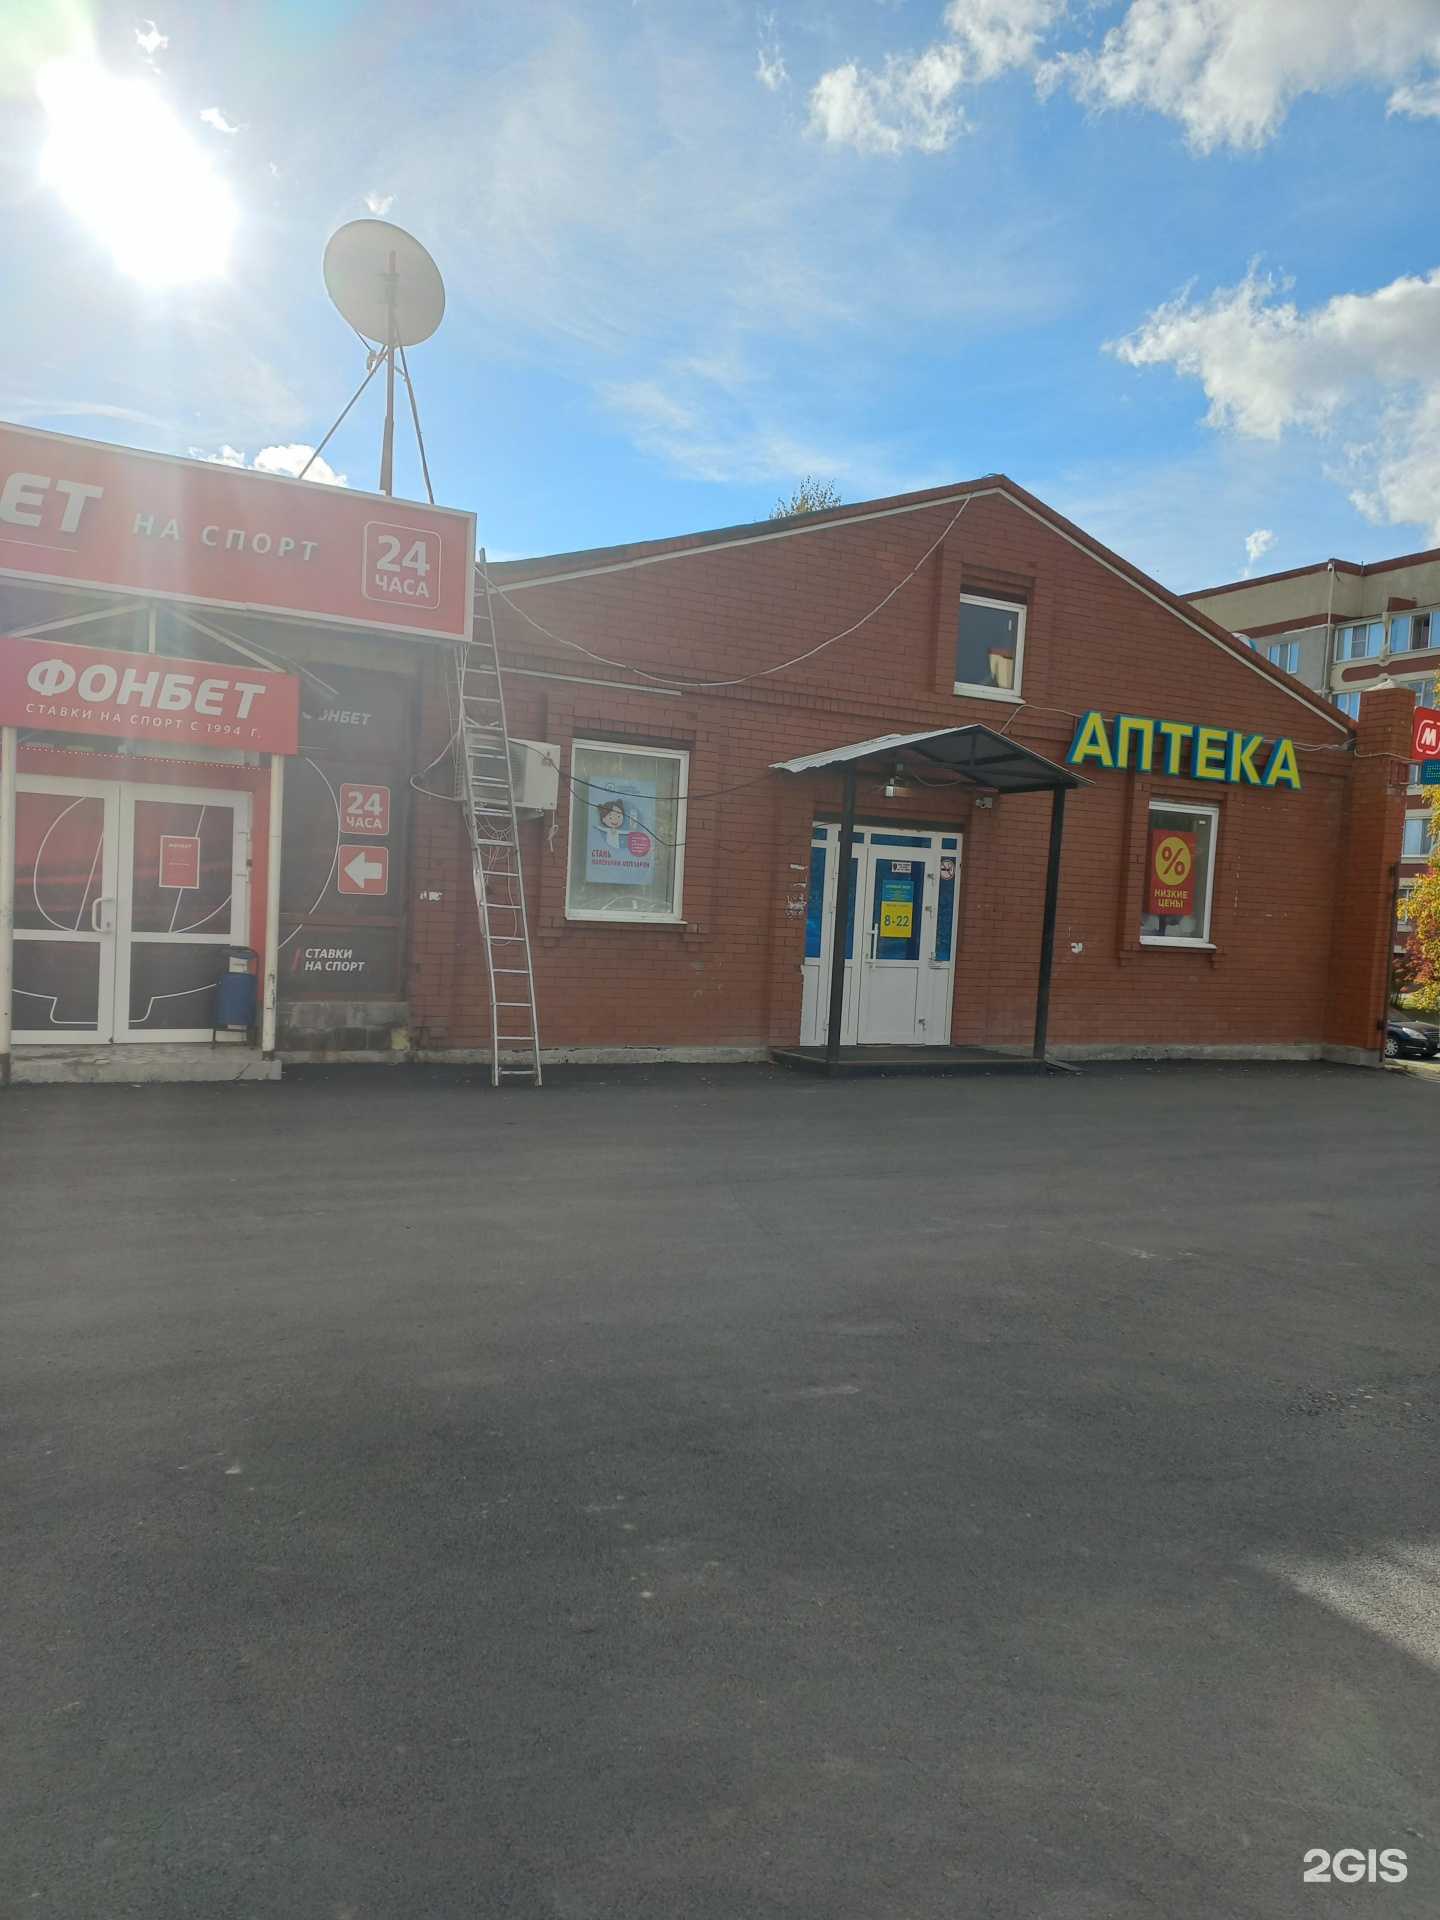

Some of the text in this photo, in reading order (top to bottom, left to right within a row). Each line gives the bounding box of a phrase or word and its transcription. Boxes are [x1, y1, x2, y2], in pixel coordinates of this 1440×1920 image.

[132, 512, 319, 561] НА СПОРТ
[377, 534, 430, 577] 24
[375, 574, 430, 599] ЧАСА
[27, 658, 265, 719] ФОНБЕТ
[25, 703, 92, 720] СТАВКИ
[100, 711, 121, 723] НА
[130, 714, 183, 729] СПОРТ
[206, 722, 241, 736] 1994
[302, 708, 372, 726] ОНБЕТ
[1070, 711, 1302, 790] АПТЕКА
[347, 791, 383, 816] 24
[346, 816, 383, 829] ЧАСА
[1154, 888, 1189, 899] НИЗКИЕ
[1158, 898, 1184, 909] ЦЕНЫ
[304, 961, 366, 971] НА СПОРТ
[305, 948, 353, 959] СТАВКИ
